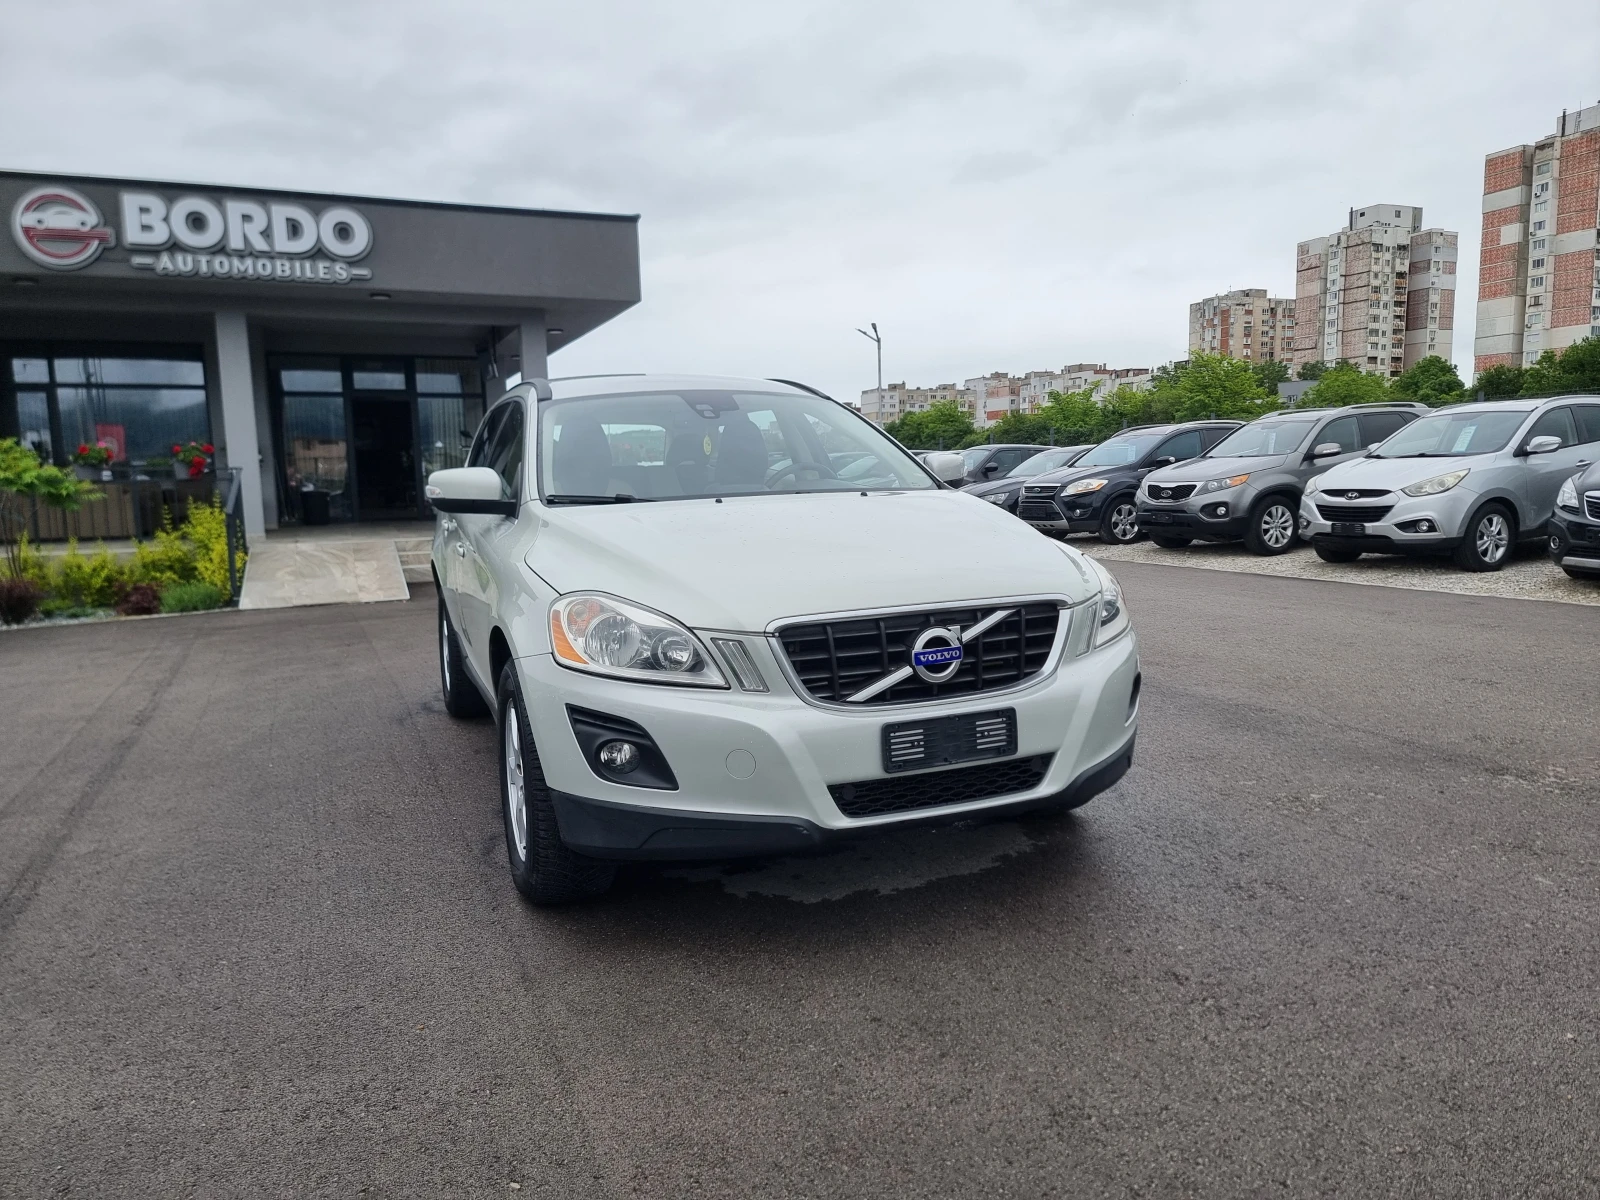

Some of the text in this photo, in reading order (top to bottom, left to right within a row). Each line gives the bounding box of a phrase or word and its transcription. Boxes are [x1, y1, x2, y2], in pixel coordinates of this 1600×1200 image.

[120, 192, 370, 257] BORDO
[158, 252, 349, 280] AUTOMOBILES
[918, 650, 960, 662] VOLVO
